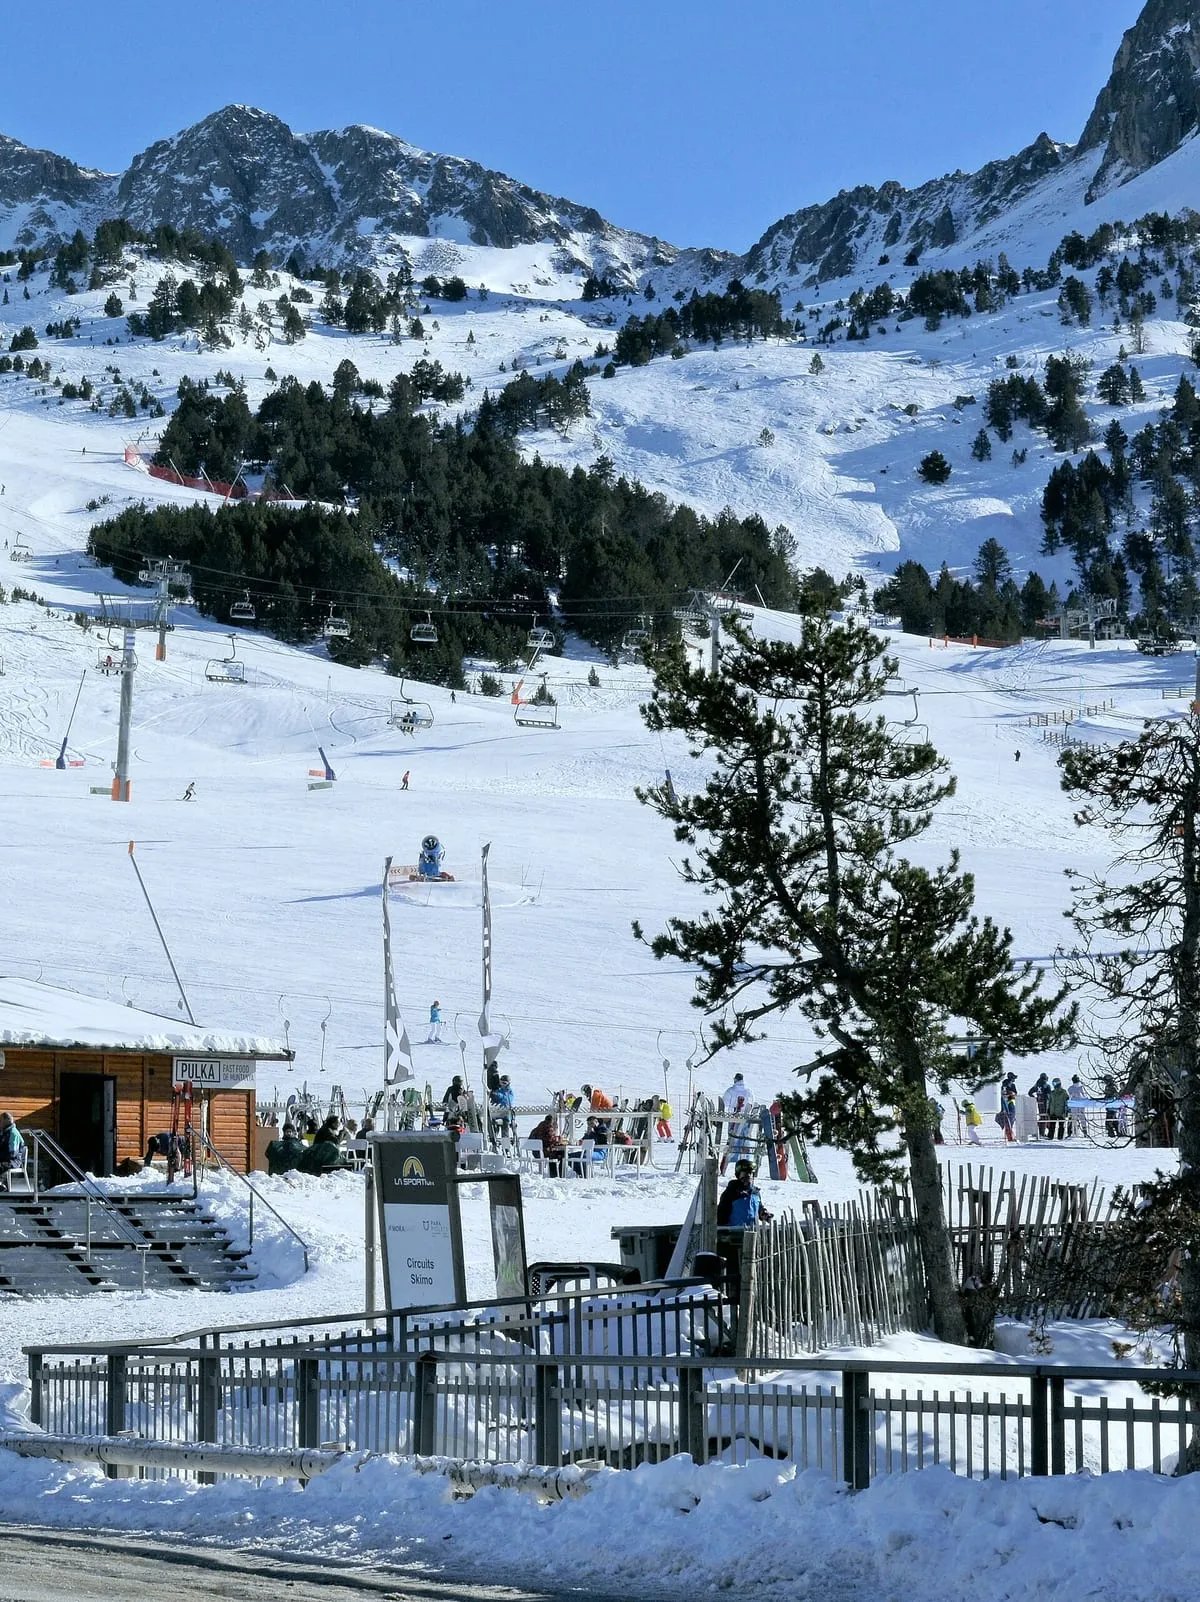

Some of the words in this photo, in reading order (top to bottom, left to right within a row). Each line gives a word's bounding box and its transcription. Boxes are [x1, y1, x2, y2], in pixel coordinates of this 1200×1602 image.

[181, 1063, 215, 1079] PULKA
[222, 1064, 235, 1073] FAST
[236, 1064, 250, 1074] FOOD
[406, 1257, 435, 1270] Circuits
[410, 1273, 434, 1286] Skimo
